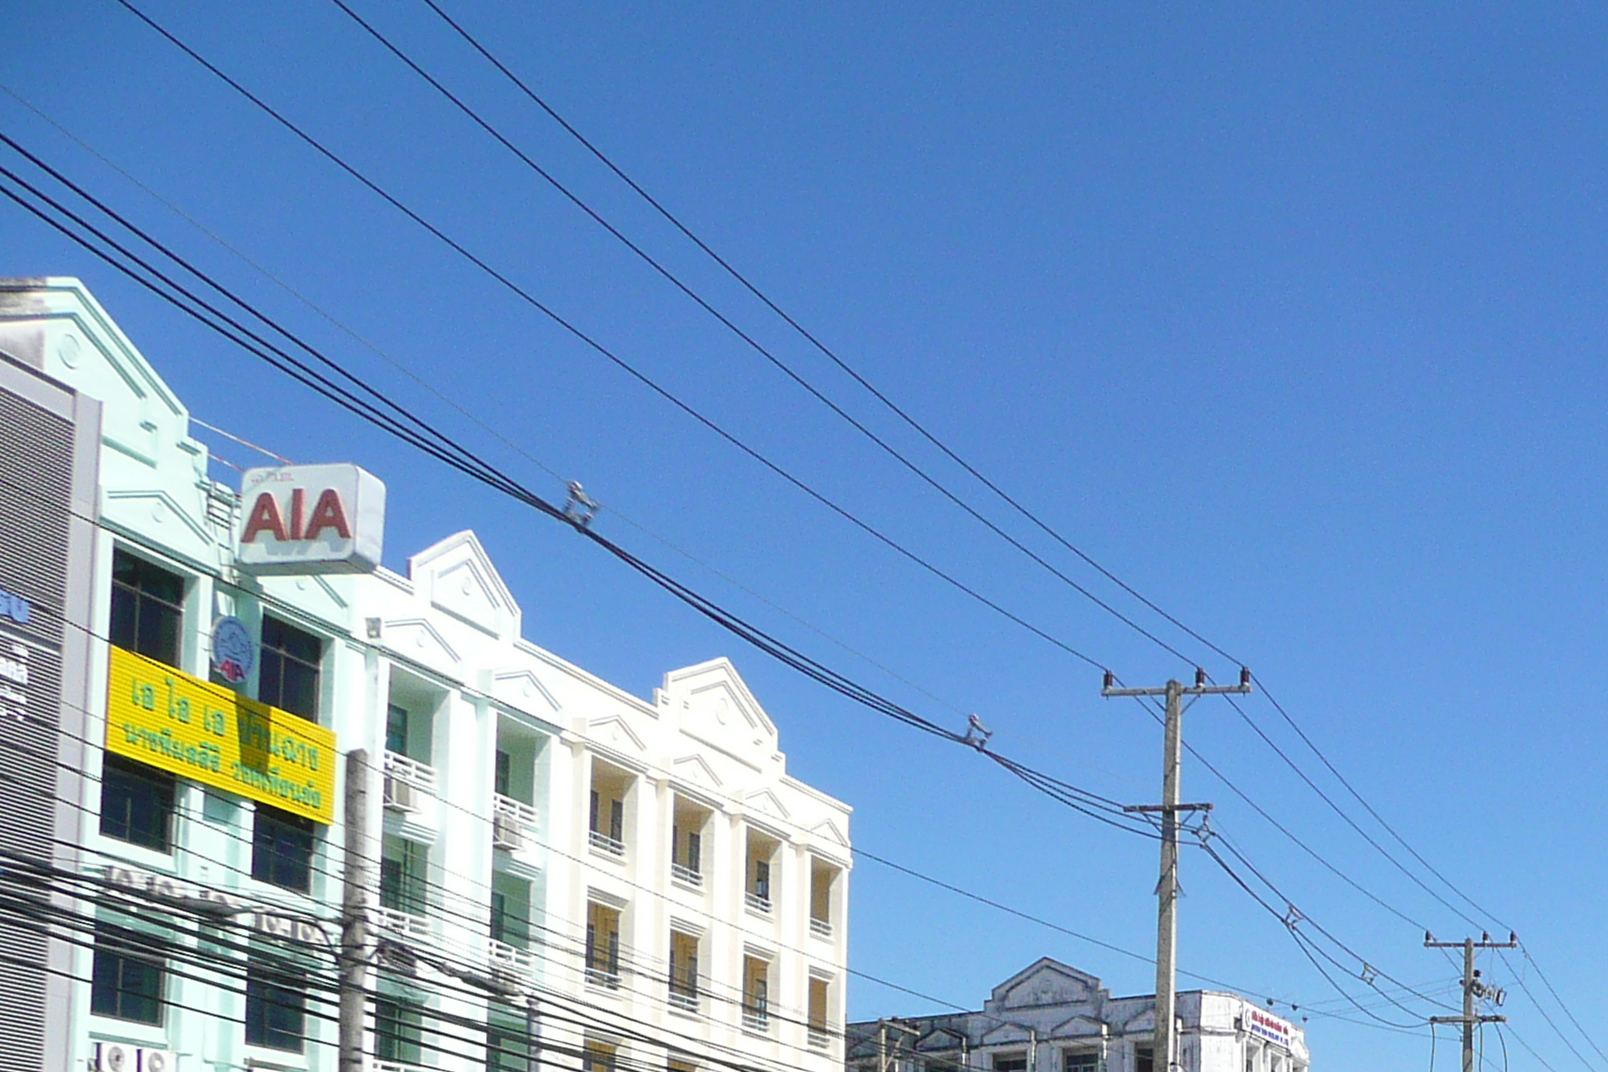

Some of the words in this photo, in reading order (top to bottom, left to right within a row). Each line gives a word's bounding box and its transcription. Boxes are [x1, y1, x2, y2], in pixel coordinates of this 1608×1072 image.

[240, 488, 352, 543] AIA
[132, 678, 155, 711] เอ
[165, 676, 190, 723] ไอ
[203, 704, 225, 736] เอ
